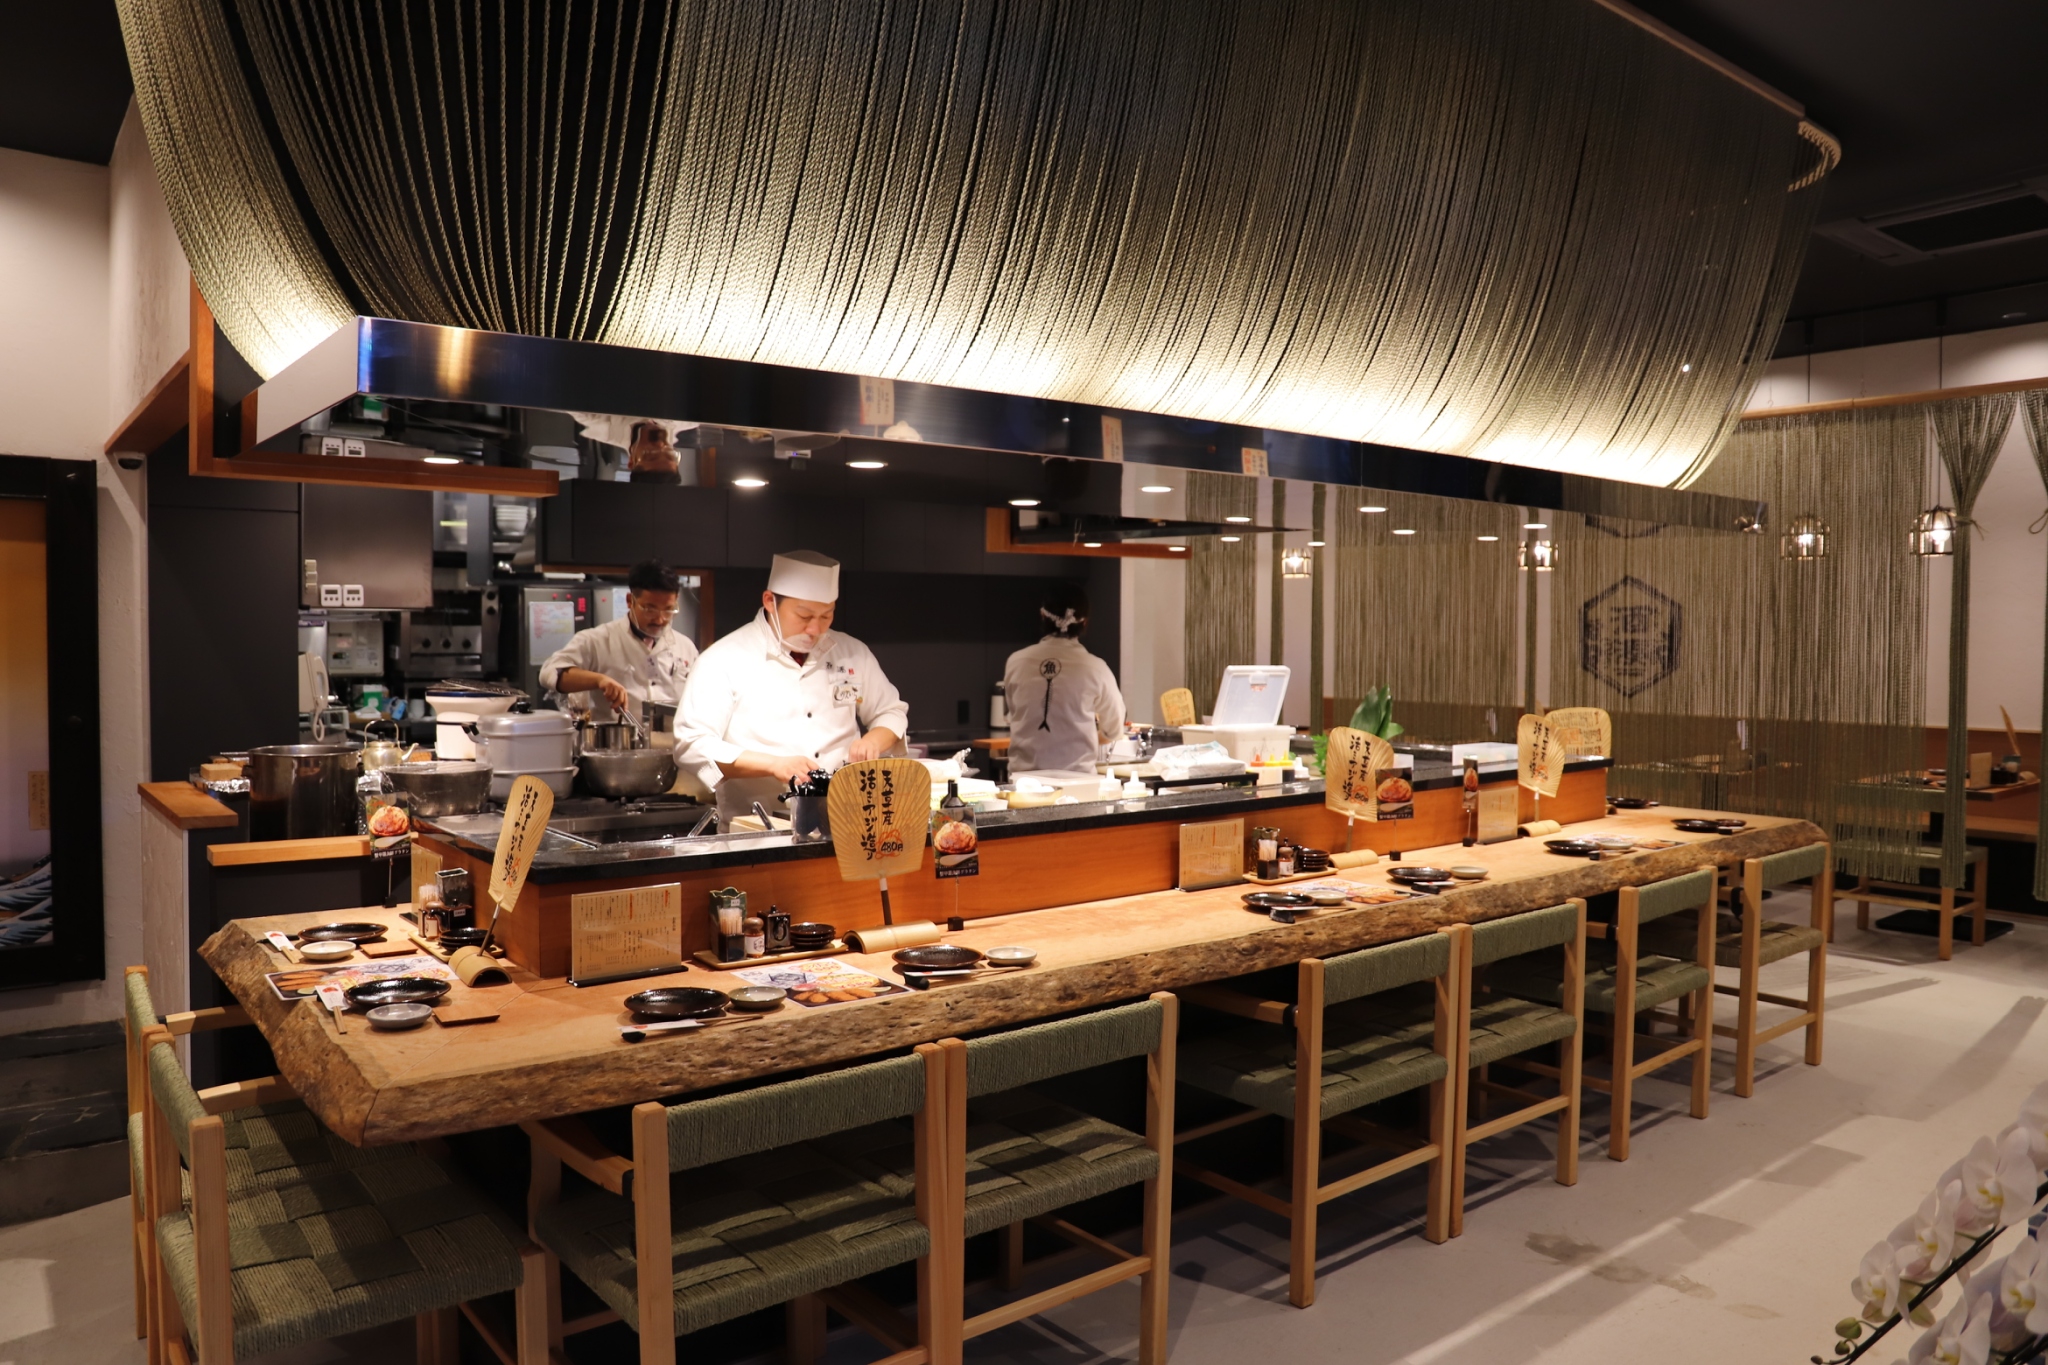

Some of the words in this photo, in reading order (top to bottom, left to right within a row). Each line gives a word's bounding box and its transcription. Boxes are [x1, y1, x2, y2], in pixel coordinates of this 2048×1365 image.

[1043, 661, 1056, 675] 魚
[859, 768, 878, 861] 活きアジ造り
[881, 769, 895, 826] 天草産
[881, 841, 904, 853] 480円
